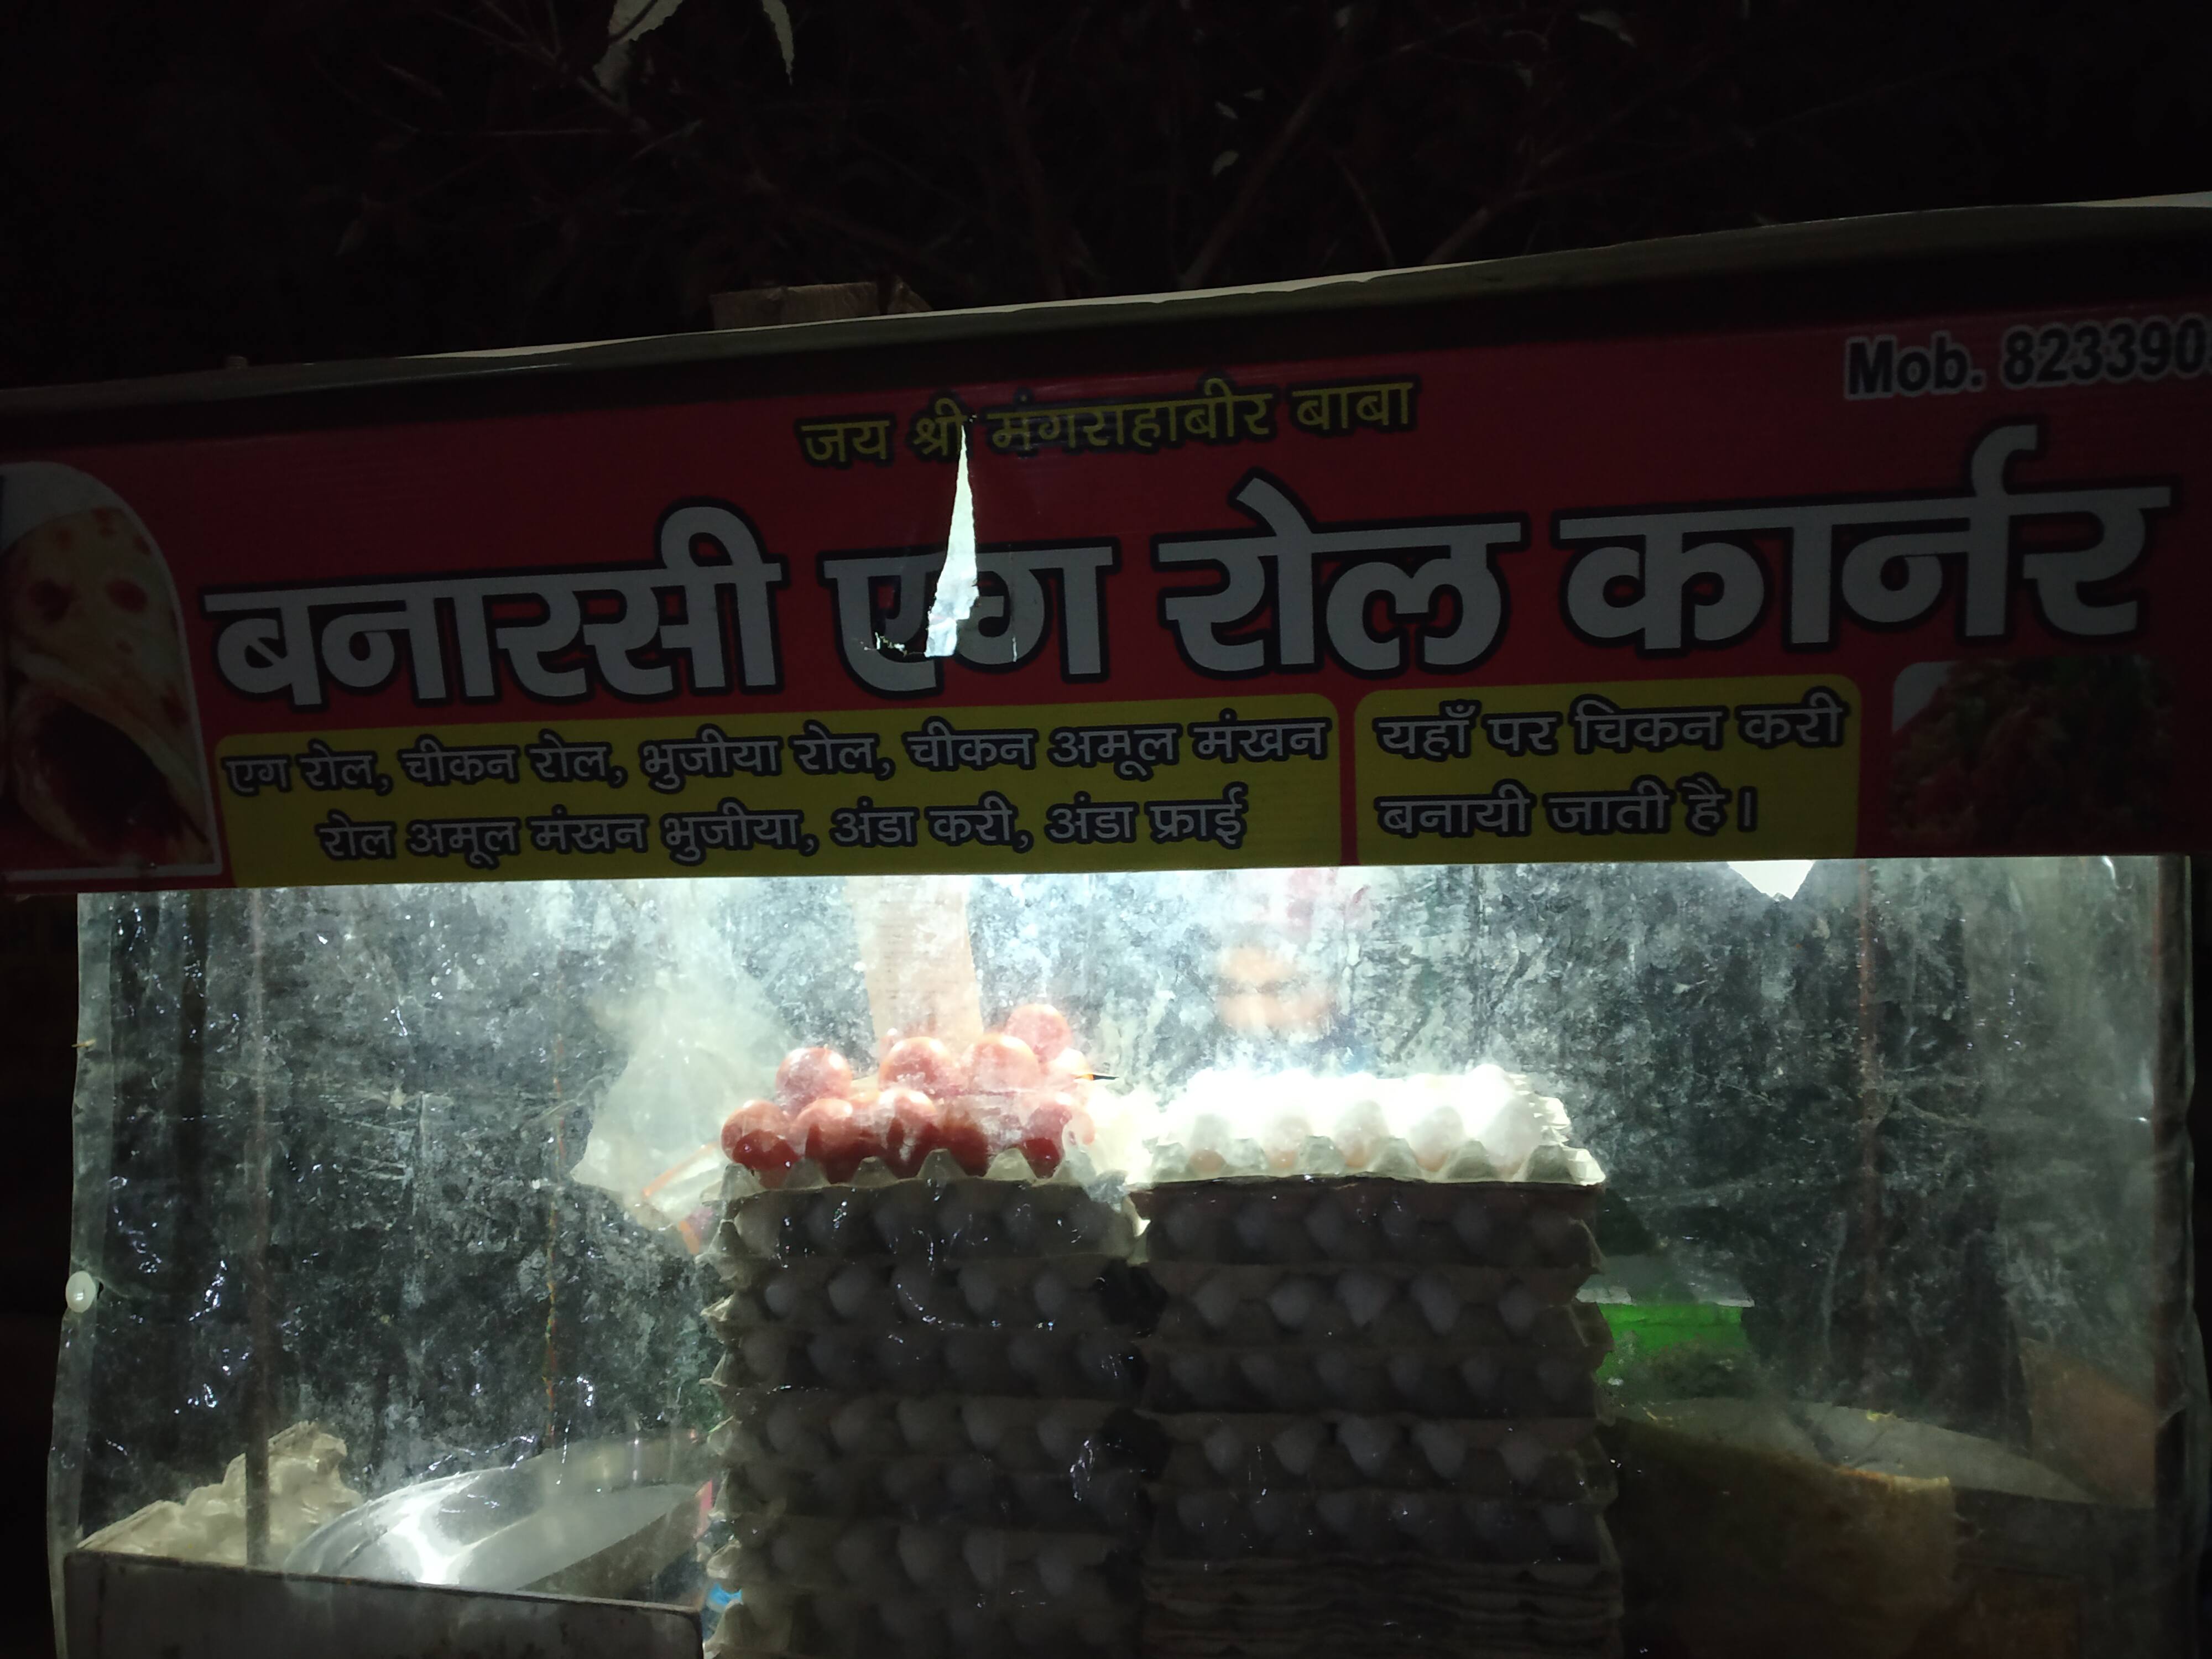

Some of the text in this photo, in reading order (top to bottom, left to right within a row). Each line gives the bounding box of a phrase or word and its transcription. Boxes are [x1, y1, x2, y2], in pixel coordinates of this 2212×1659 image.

[1844, 312, 2212, 400] Mob. 823390
[800, 419, 890, 464] जय
[912, 397, 967, 458] श्री
[1293, 382, 1413, 432] बाबा
[203, 423, 2172, 706] बनारसी एग रोल कार्नर
[226, 712, 1327, 793] एग रोल, चीकन रोल, भुजीया रोल, चीकन अमूल मंखन
[1378, 692, 1845, 758] यहाँ पर चिकन करी
[318, 785, 1244, 865] रोल अमूल मंखन भुजीया, अंडा करी, अंडा फ्राई
[1379, 783, 1531, 834] बनायी
[1548, 779, 1671, 831] जाती
